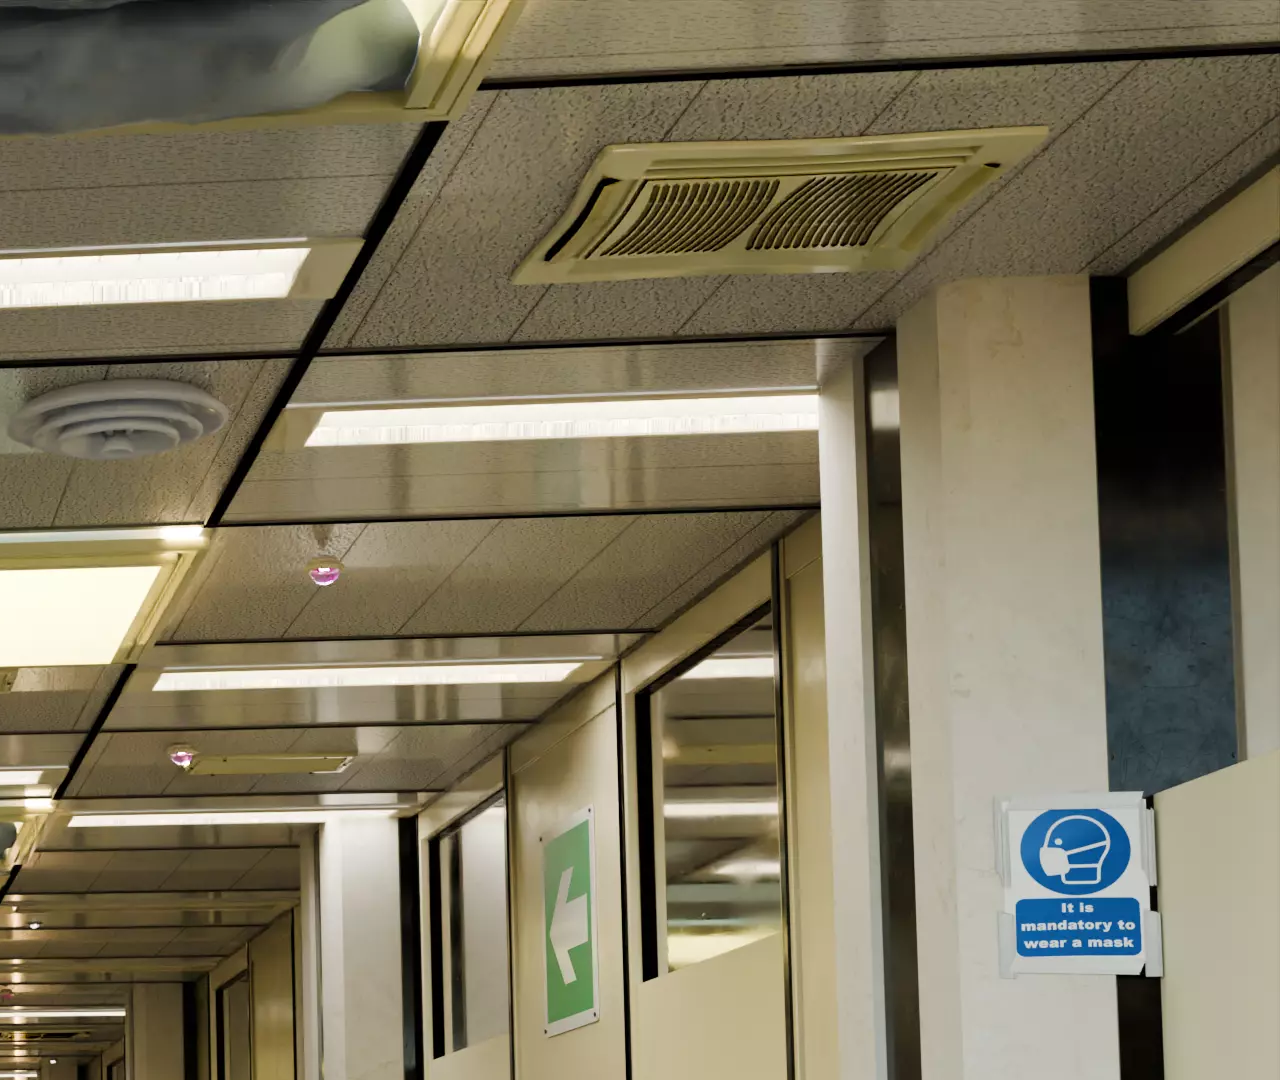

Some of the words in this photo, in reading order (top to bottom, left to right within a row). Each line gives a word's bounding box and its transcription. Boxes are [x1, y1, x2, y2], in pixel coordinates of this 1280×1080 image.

[1061, 902, 1075, 913] It
[1079, 902, 1094, 913] is
[1020, 919, 1113, 933] mandatory
[1117, 919, 1136, 931] to
[1023, 938, 1067, 949] wear
[1071, 938, 1083, 948] a
[1087, 936, 1135, 948] mask
